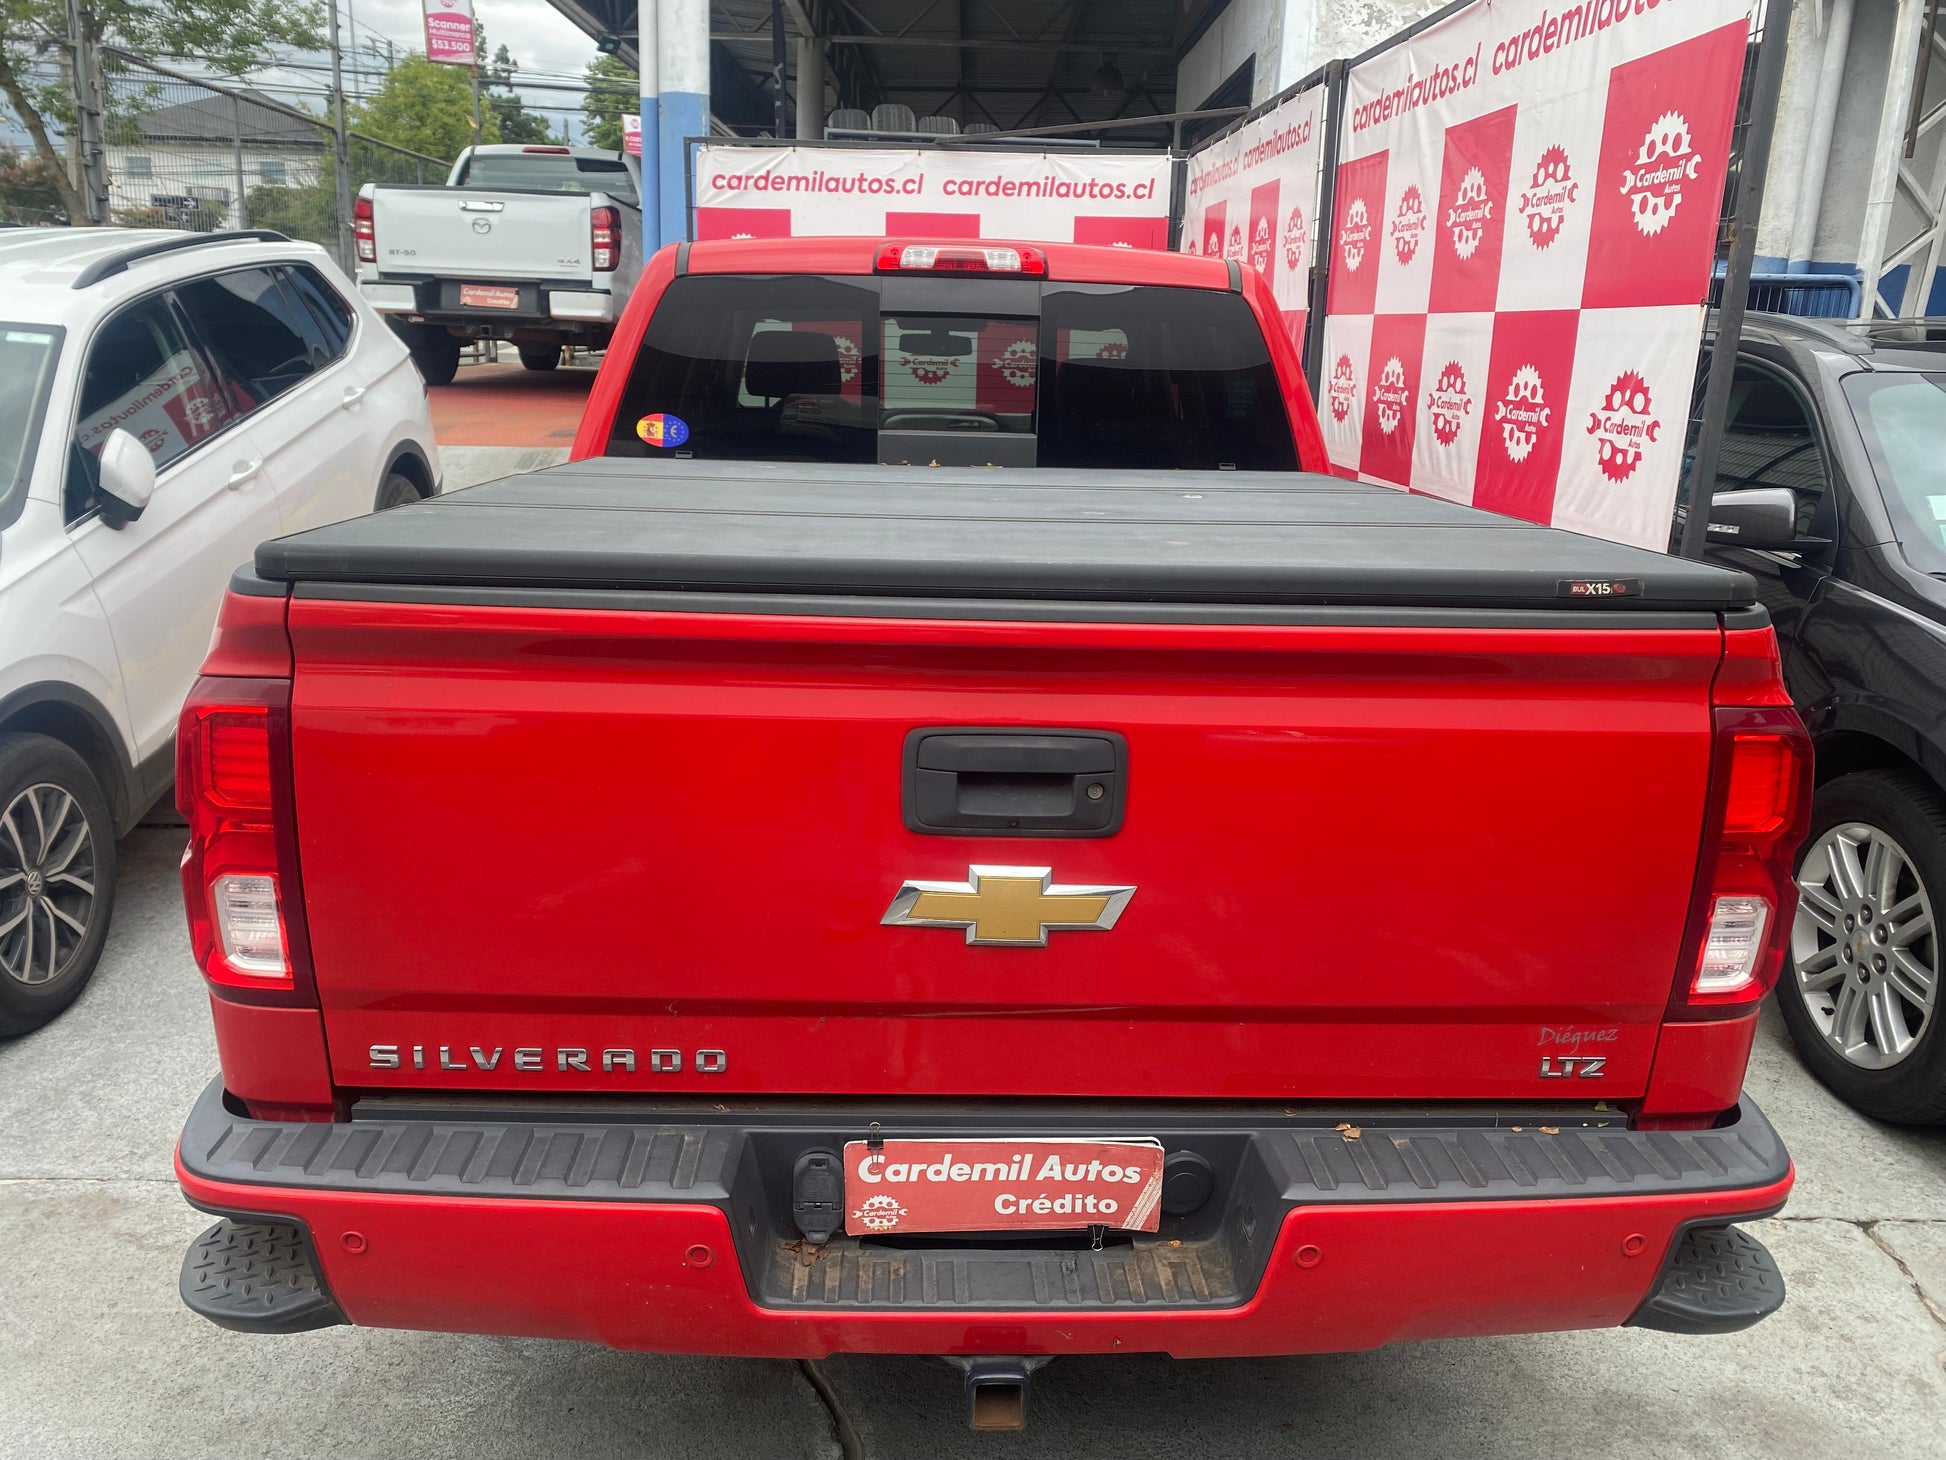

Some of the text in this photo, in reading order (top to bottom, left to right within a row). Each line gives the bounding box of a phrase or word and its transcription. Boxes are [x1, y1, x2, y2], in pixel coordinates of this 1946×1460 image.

[428, 17, 471, 31] Scanner
[431, 38, 470, 52] $53.500
[1352, 42, 1481, 133] cardemilautos.cl
[1243, 111, 1313, 171] cardemilautos.cl
[1636, 158, 1687, 187] Cardemil
[711, 171, 1156, 200] cardemilautos.cl cardemilautos.cl
[1530, 186, 1567, 208] Cardemil
[1506, 404, 1541, 423] Cardemil
[1603, 416, 1647, 438] Cardemil
[369, 1044, 727, 1073] SILVERADO
[1540, 1056, 1607, 1078] LTZ
[857, 1154, 1141, 1184] Cardemil Autos
[863, 1208, 898, 1217] Cardemil
[993, 1192, 1119, 1215] Crédito
